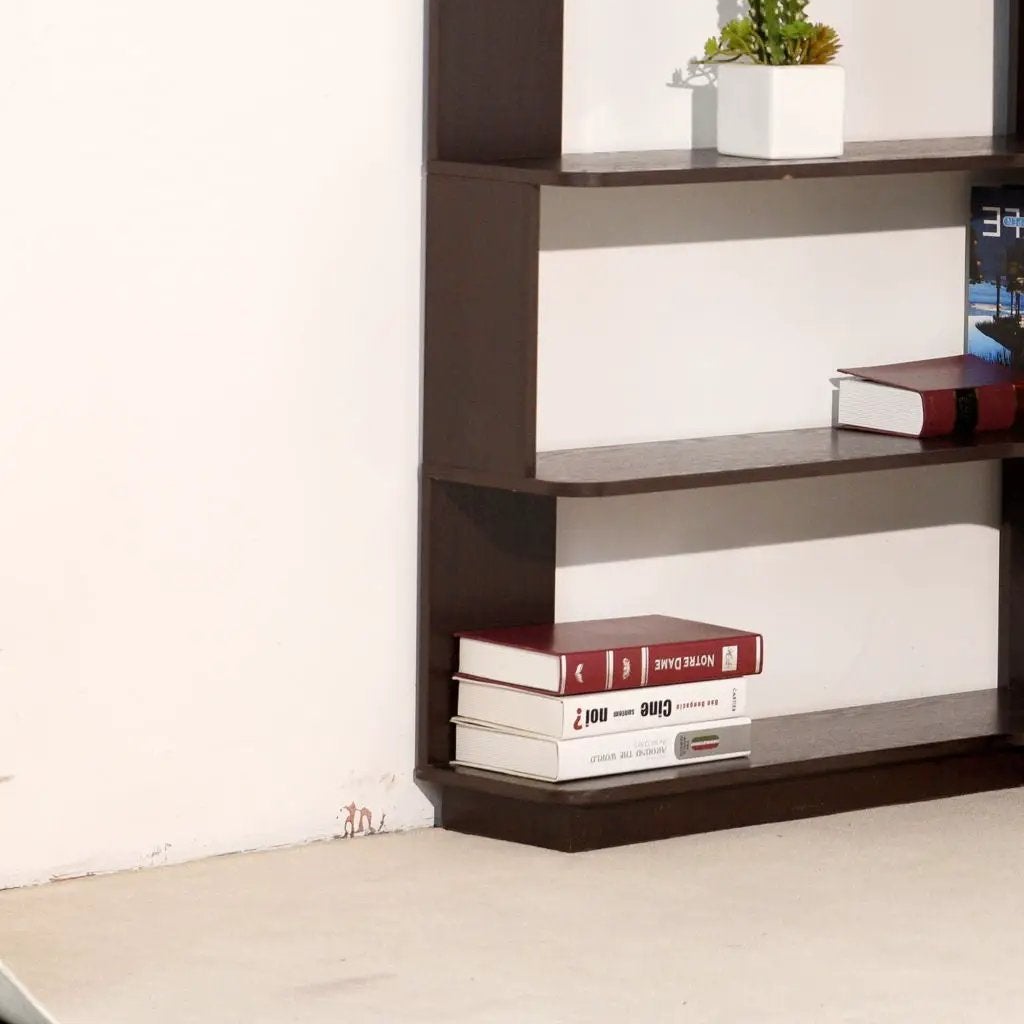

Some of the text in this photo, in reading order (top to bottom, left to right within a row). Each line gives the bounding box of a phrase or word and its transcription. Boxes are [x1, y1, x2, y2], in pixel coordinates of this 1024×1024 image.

[654, 653, 715, 671] NOTRE DAME
[640, 699, 673, 717] Cine
[573, 707, 609, 731] noi?
[590, 753, 617, 763] WORLD
[619, 750, 633, 760] THE
